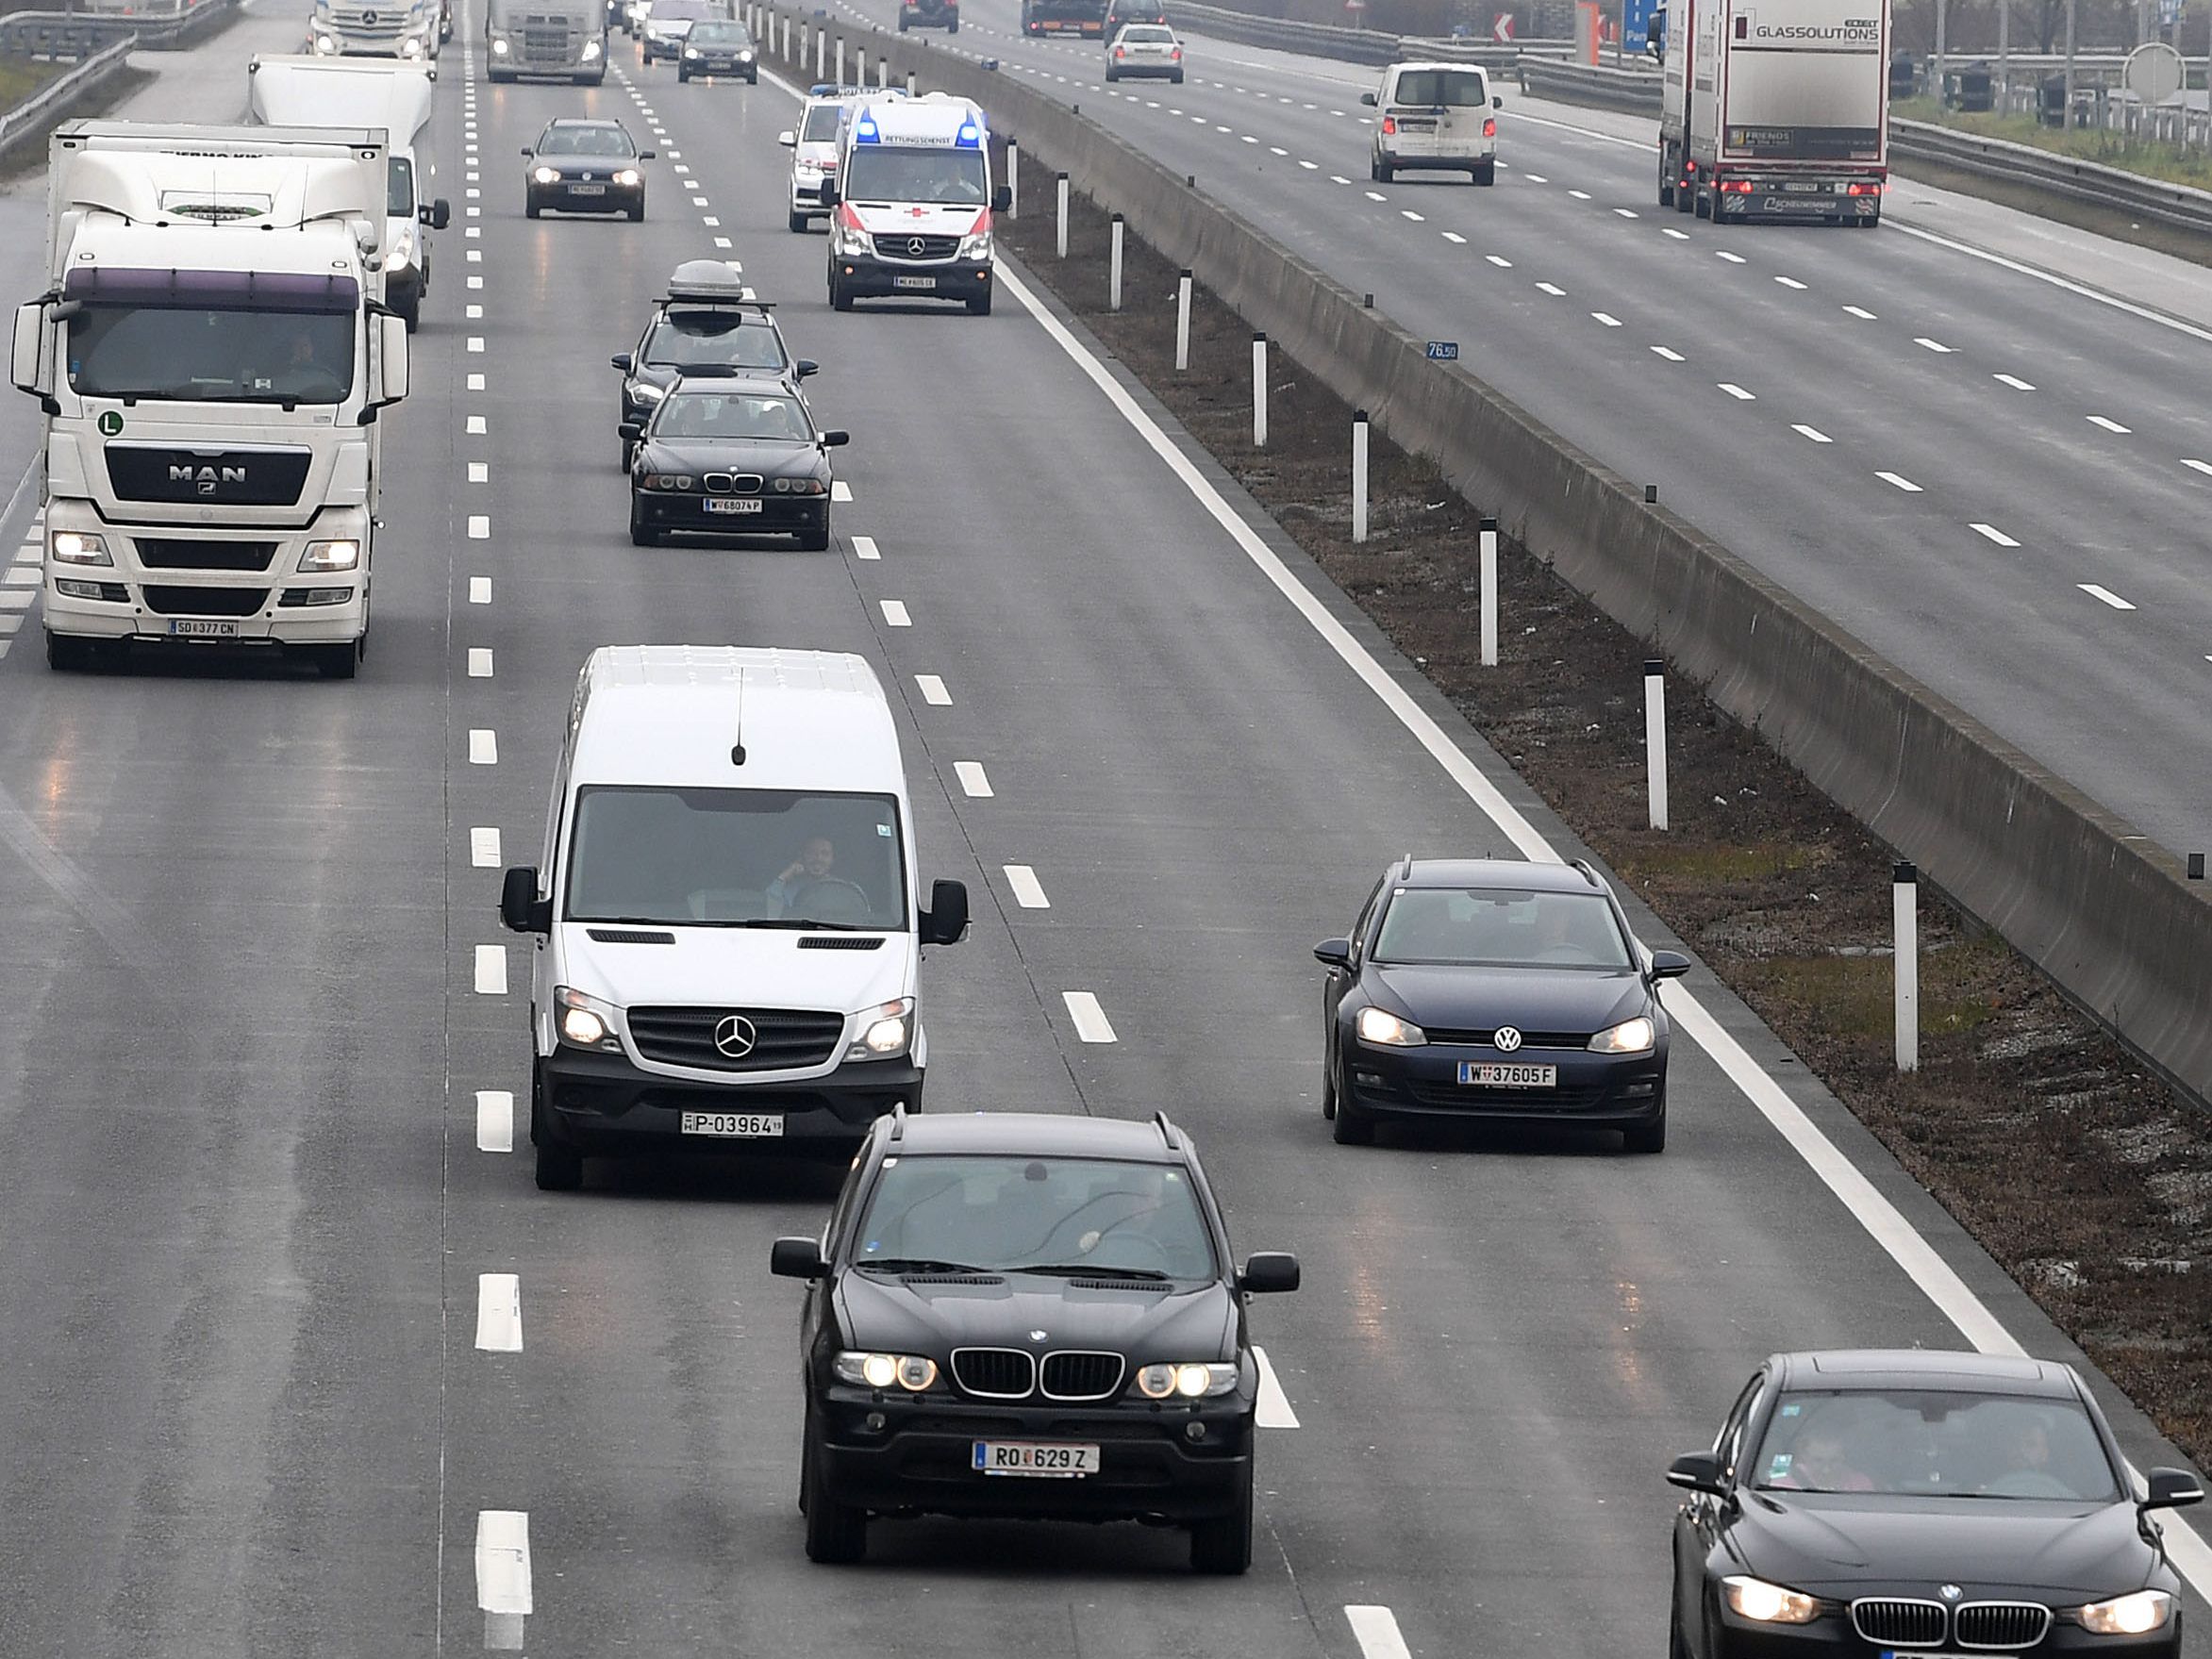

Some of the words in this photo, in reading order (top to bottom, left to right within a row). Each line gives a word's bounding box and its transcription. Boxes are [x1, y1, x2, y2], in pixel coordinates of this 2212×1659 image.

[1756, 25, 1878, 40] GLASSOLUTIONS
[104, 414, 117, 433] L
[169, 465, 246, 482] MAN
